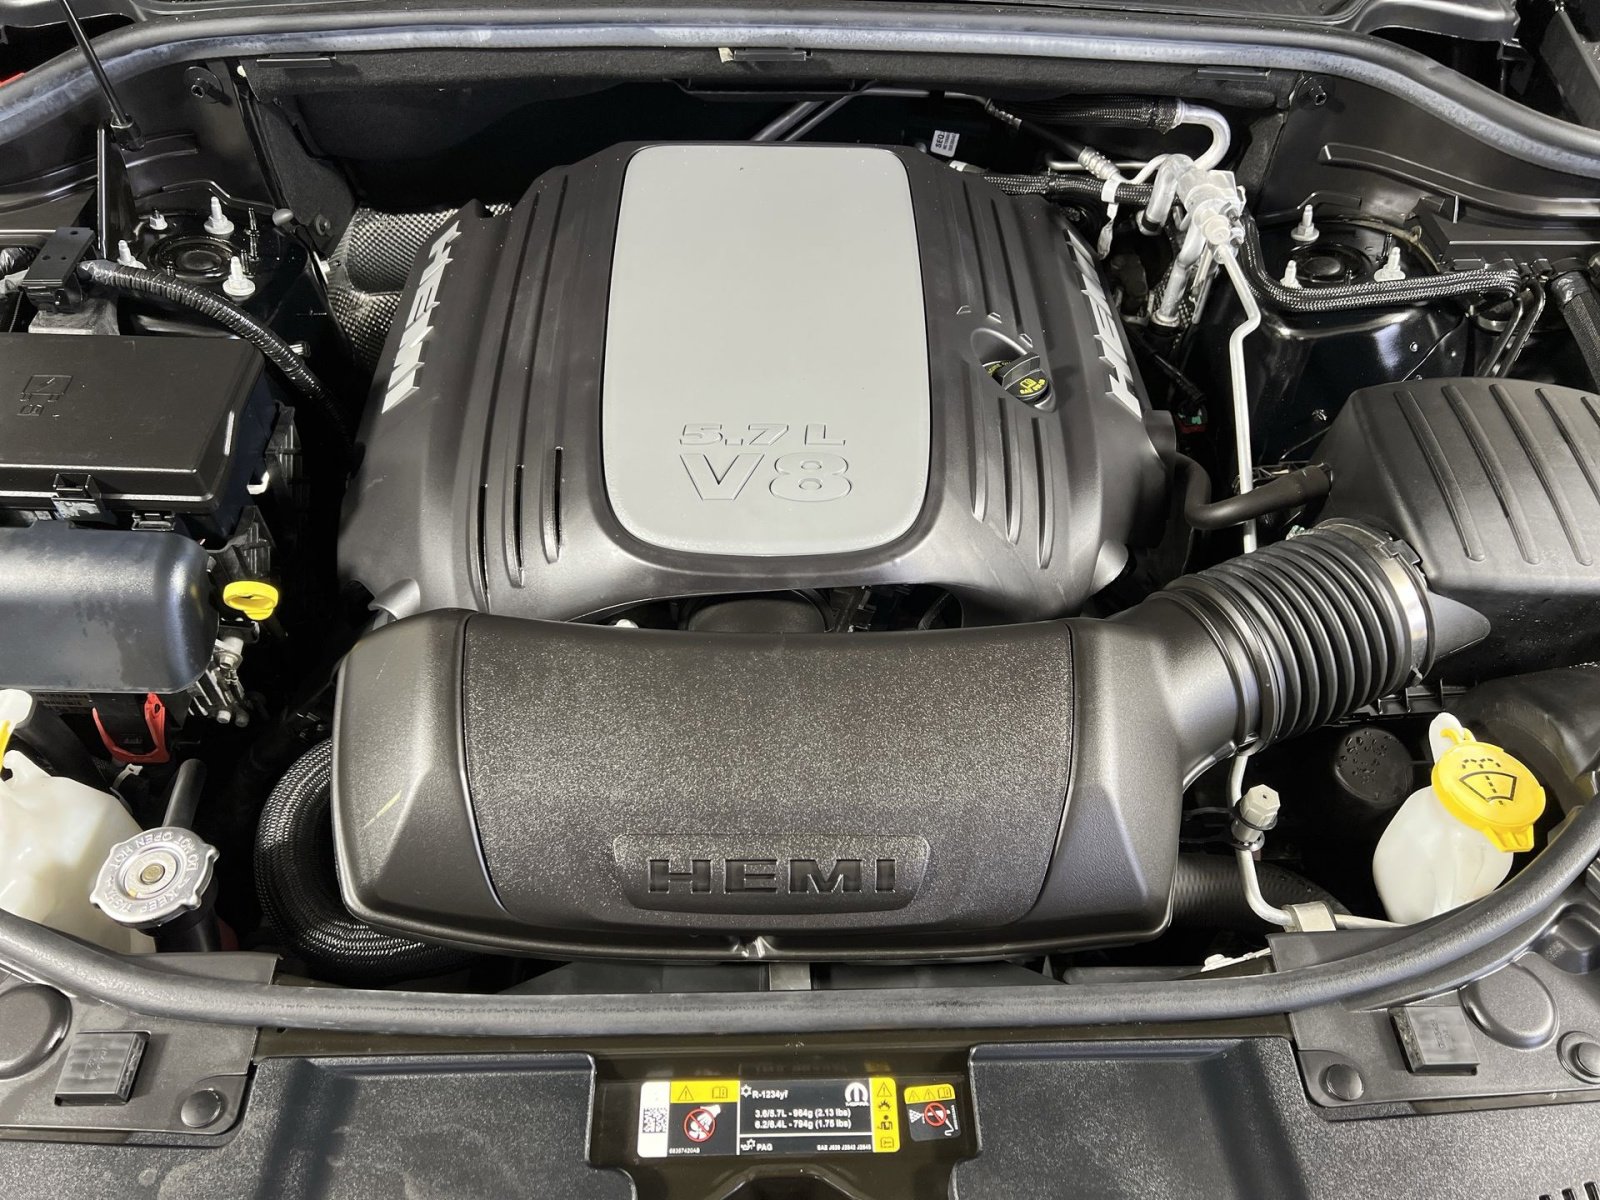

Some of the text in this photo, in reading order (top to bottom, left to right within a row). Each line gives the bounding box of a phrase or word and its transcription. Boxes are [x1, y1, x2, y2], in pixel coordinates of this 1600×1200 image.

[381, 220, 462, 415] HEMI
[679, 452, 852, 503] V8
[135, 830, 174, 847] OPEN
[109, 846, 134, 871] HOT
[648, 857, 897, 895] HEMI
[140, 890, 178, 913] KEEP
[752, 1089, 789, 1101] R-1234yf
[756, 1143, 773, 1152] PAG
